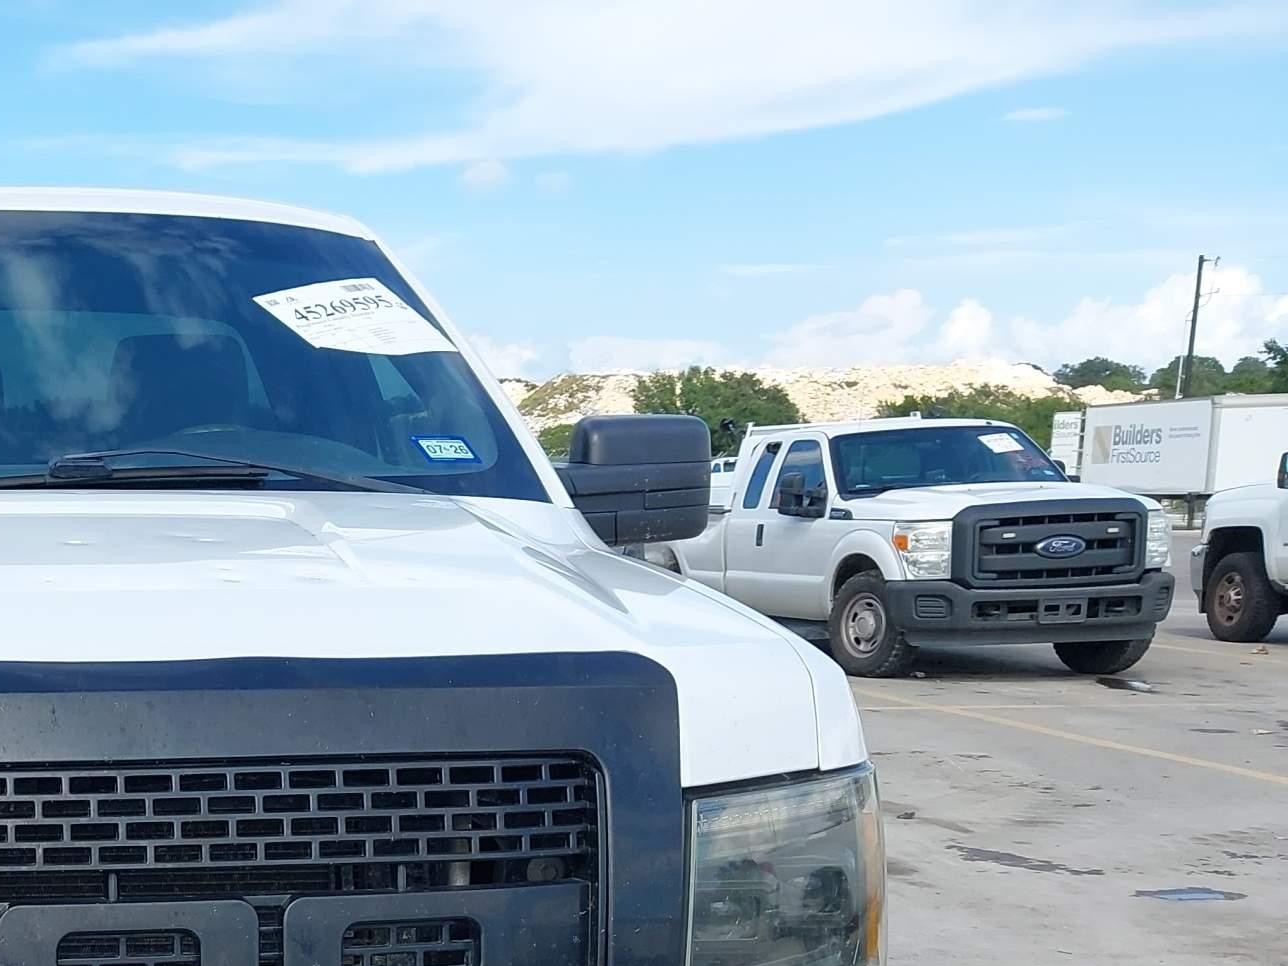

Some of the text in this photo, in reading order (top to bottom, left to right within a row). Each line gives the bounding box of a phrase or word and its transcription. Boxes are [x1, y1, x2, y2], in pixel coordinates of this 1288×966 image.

[294, 295, 393, 321] 45269595
[1113, 424, 1161, 445] Builders
[1111, 447, 1161, 463] FirstSource
